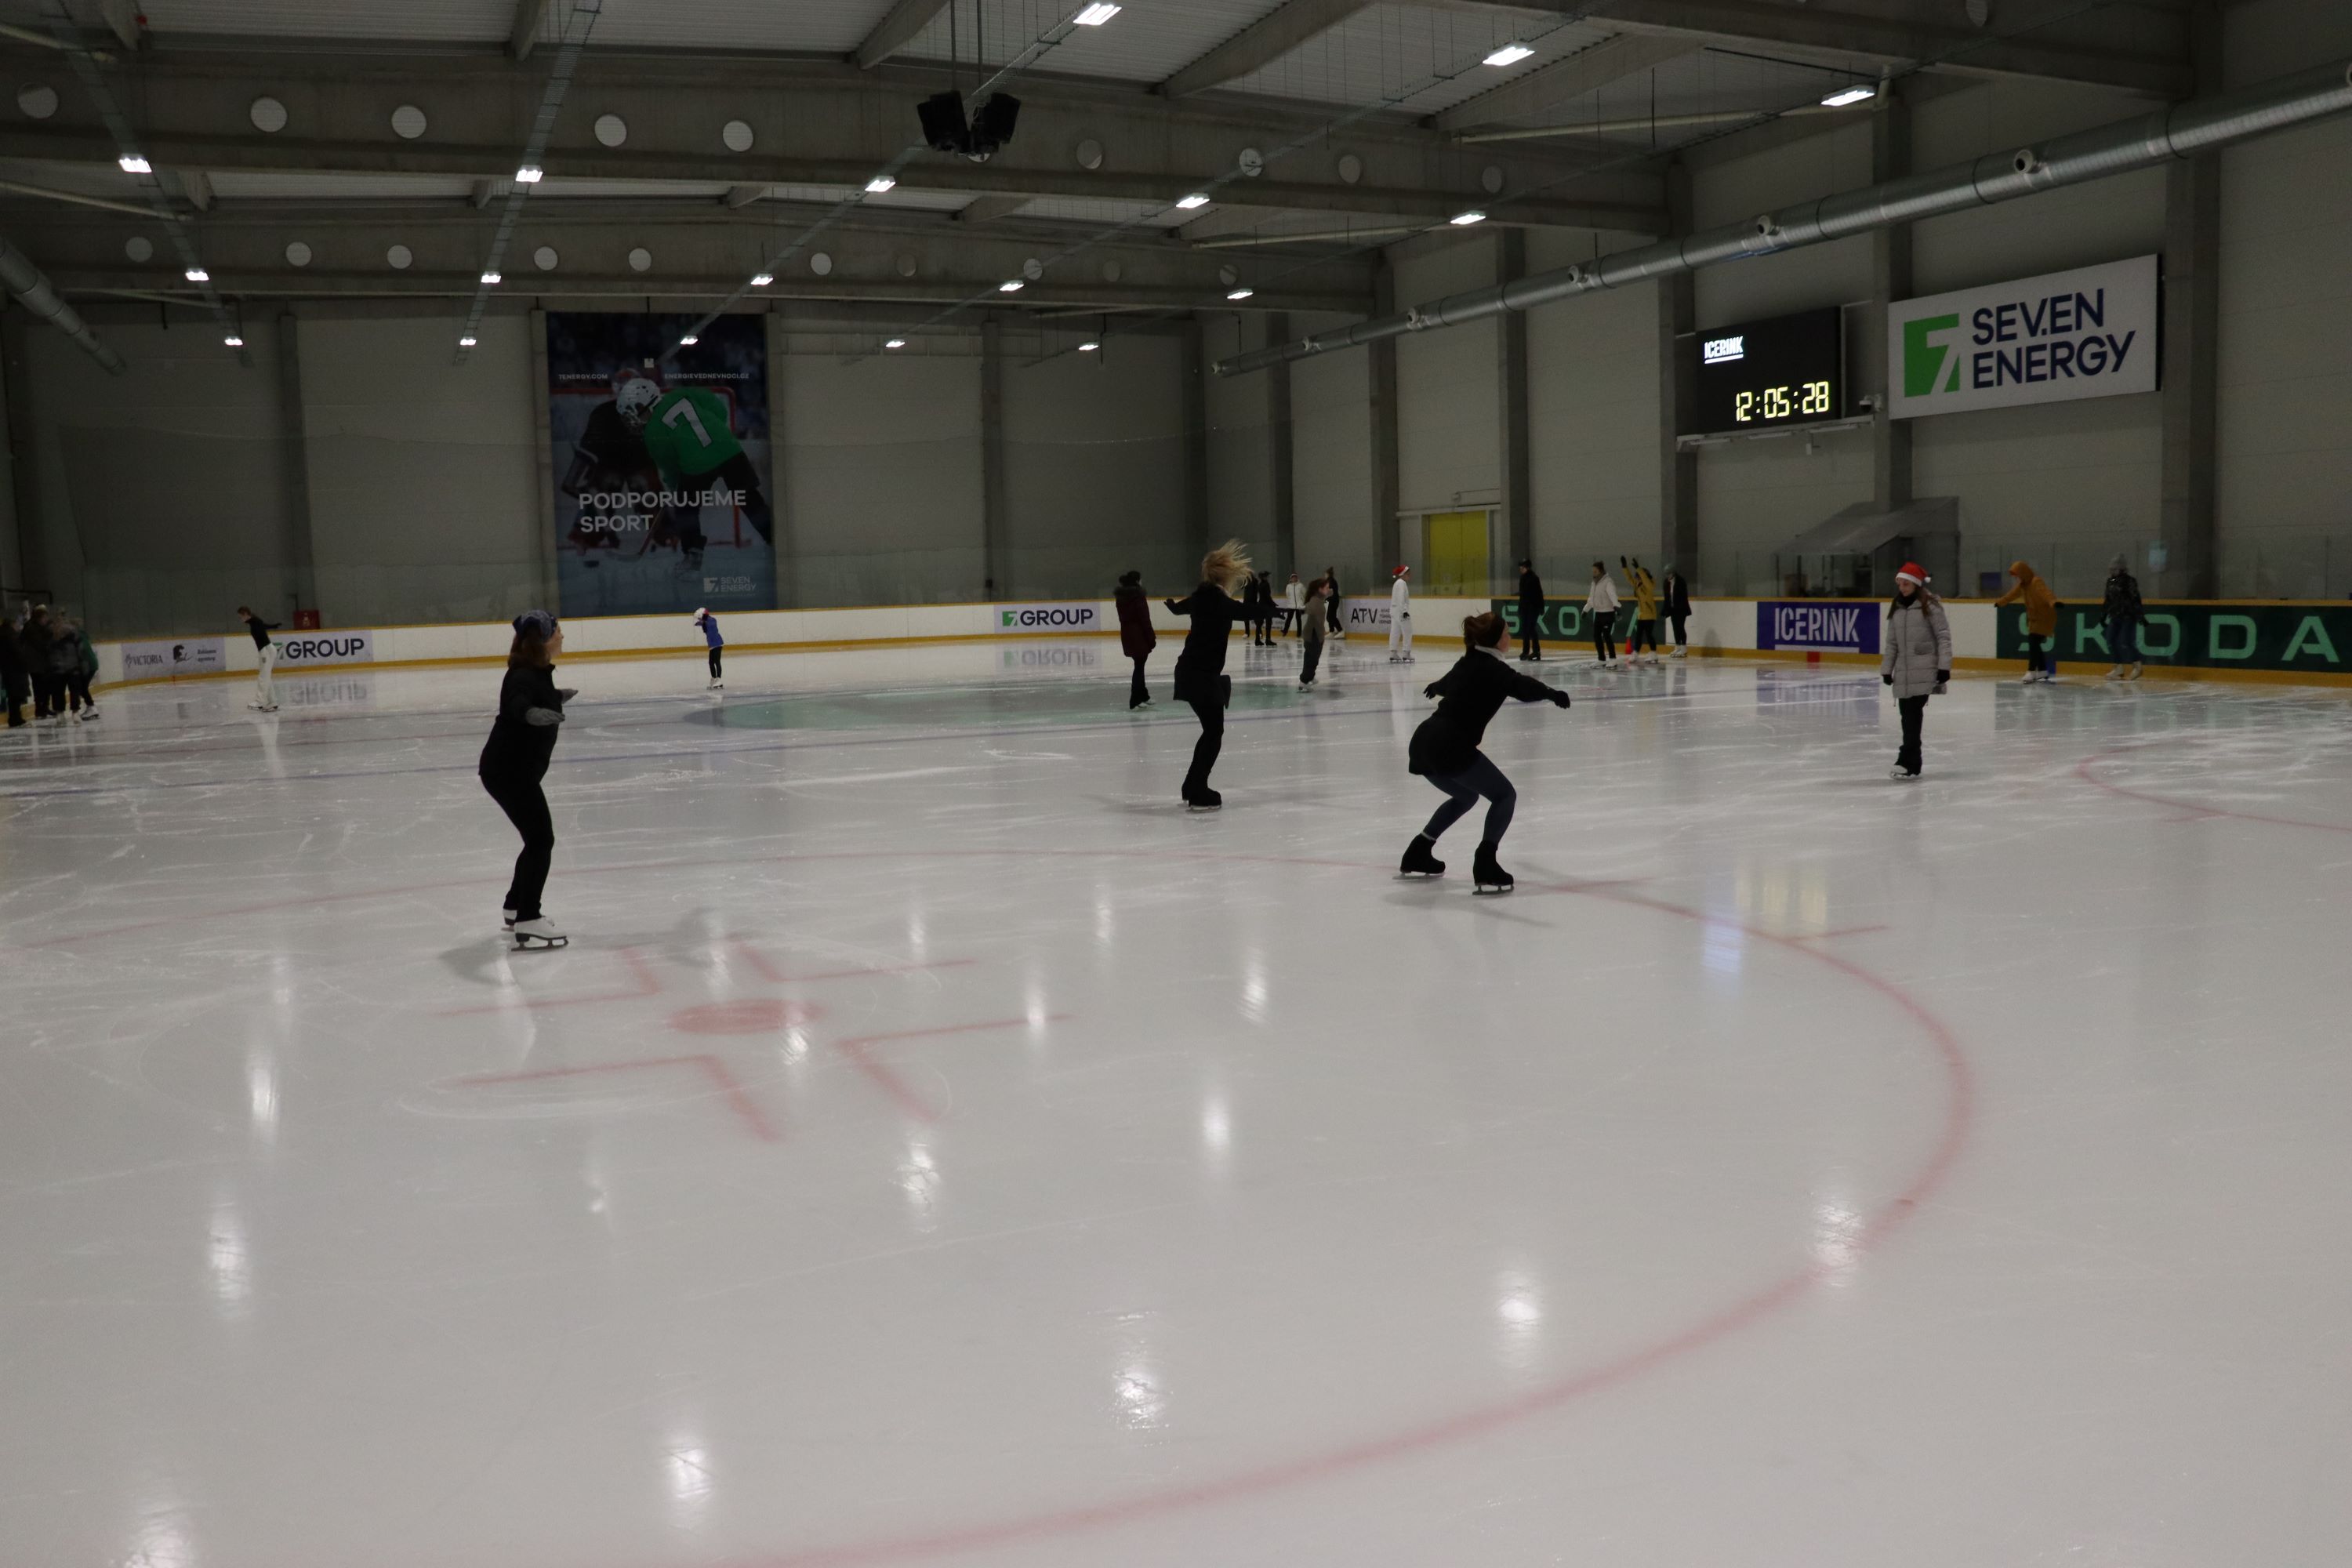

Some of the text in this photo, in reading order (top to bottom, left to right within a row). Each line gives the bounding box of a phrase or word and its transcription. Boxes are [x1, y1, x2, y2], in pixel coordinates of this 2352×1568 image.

[1972, 289, 2104, 346] SEV.EN
[1704, 336, 1744, 359] ICERINK
[1973, 330, 2136, 390] ENERGY
[1735, 381, 1829, 422] 12:05:28
[662, 397, 713, 448] 7
[579, 490, 747, 510] PODPORUJEME
[579, 514, 654, 533] SPORT
[1020, 608, 1094, 626] GROUP
[1350, 608, 1378, 624] ATV
[1774, 608, 1860, 642] ICERINK
[285, 637, 365, 659] GROUP
